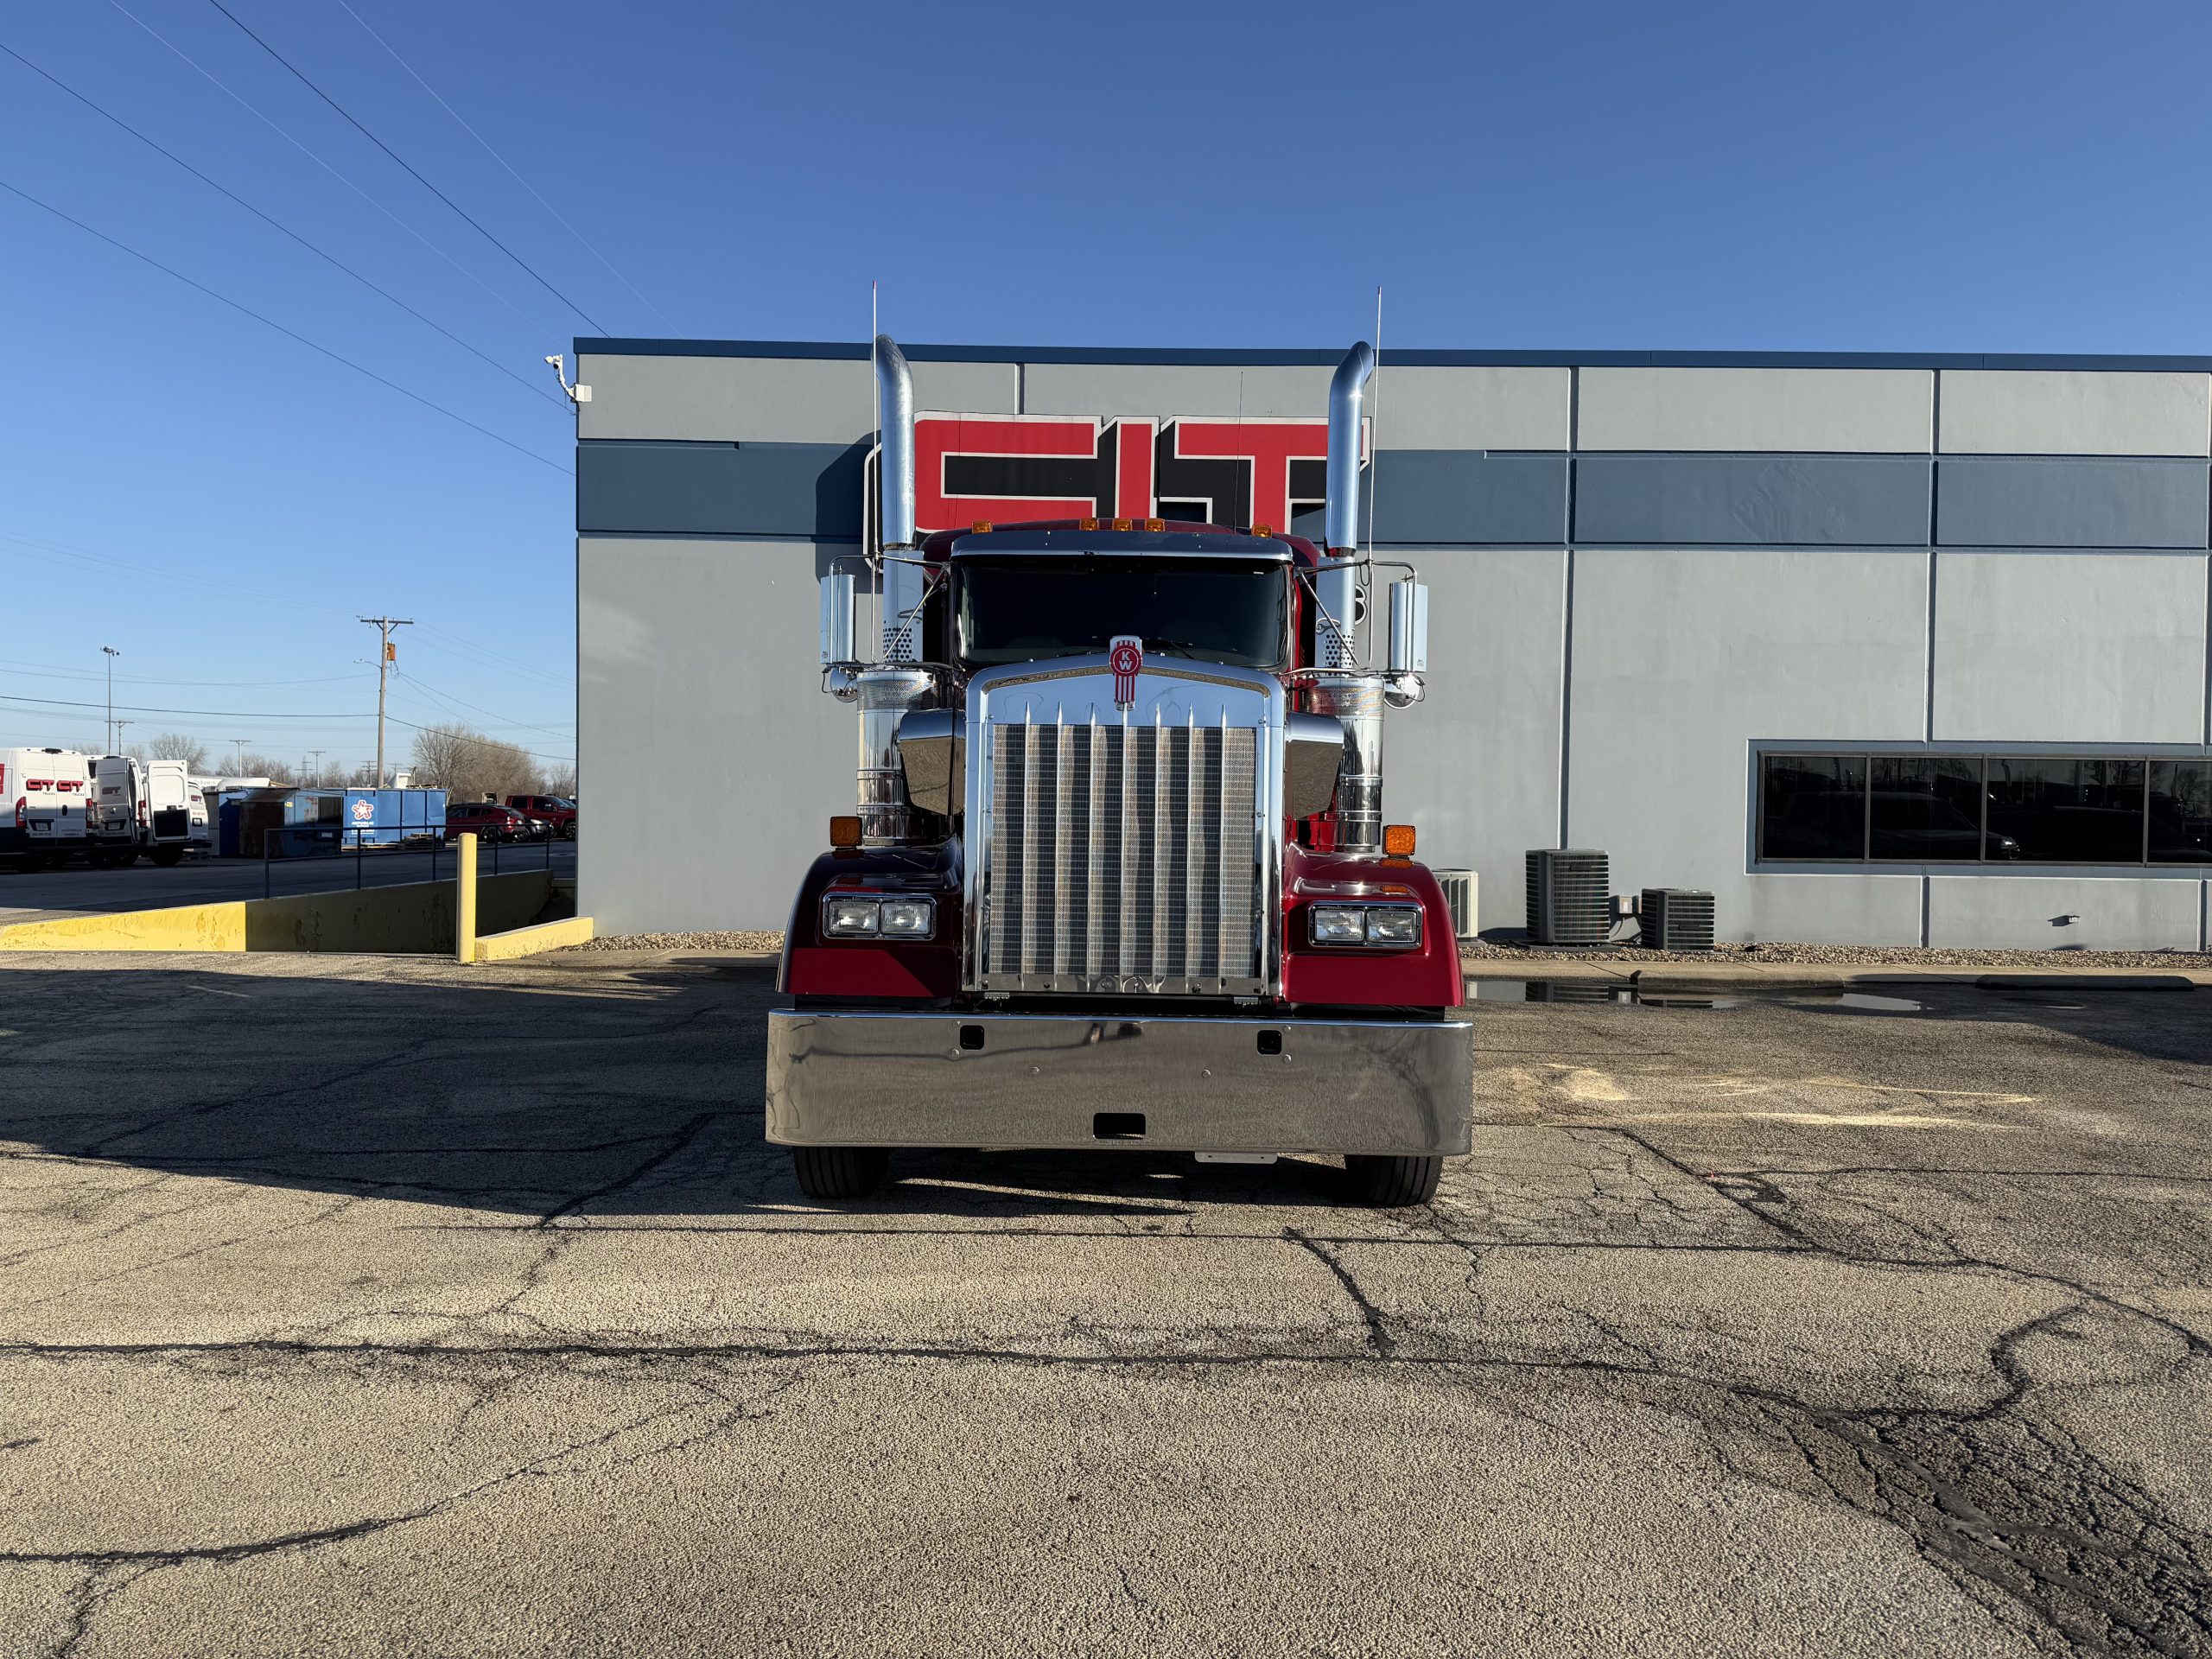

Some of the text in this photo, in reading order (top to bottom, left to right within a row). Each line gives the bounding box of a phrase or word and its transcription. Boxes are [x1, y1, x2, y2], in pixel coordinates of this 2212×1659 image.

[869, 410, 1371, 540] CIT
[1122, 651, 1130, 661] K
[1119, 660, 1133, 671] W
[26, 779, 54, 791] CIT
[56, 780, 84, 792] CIT
